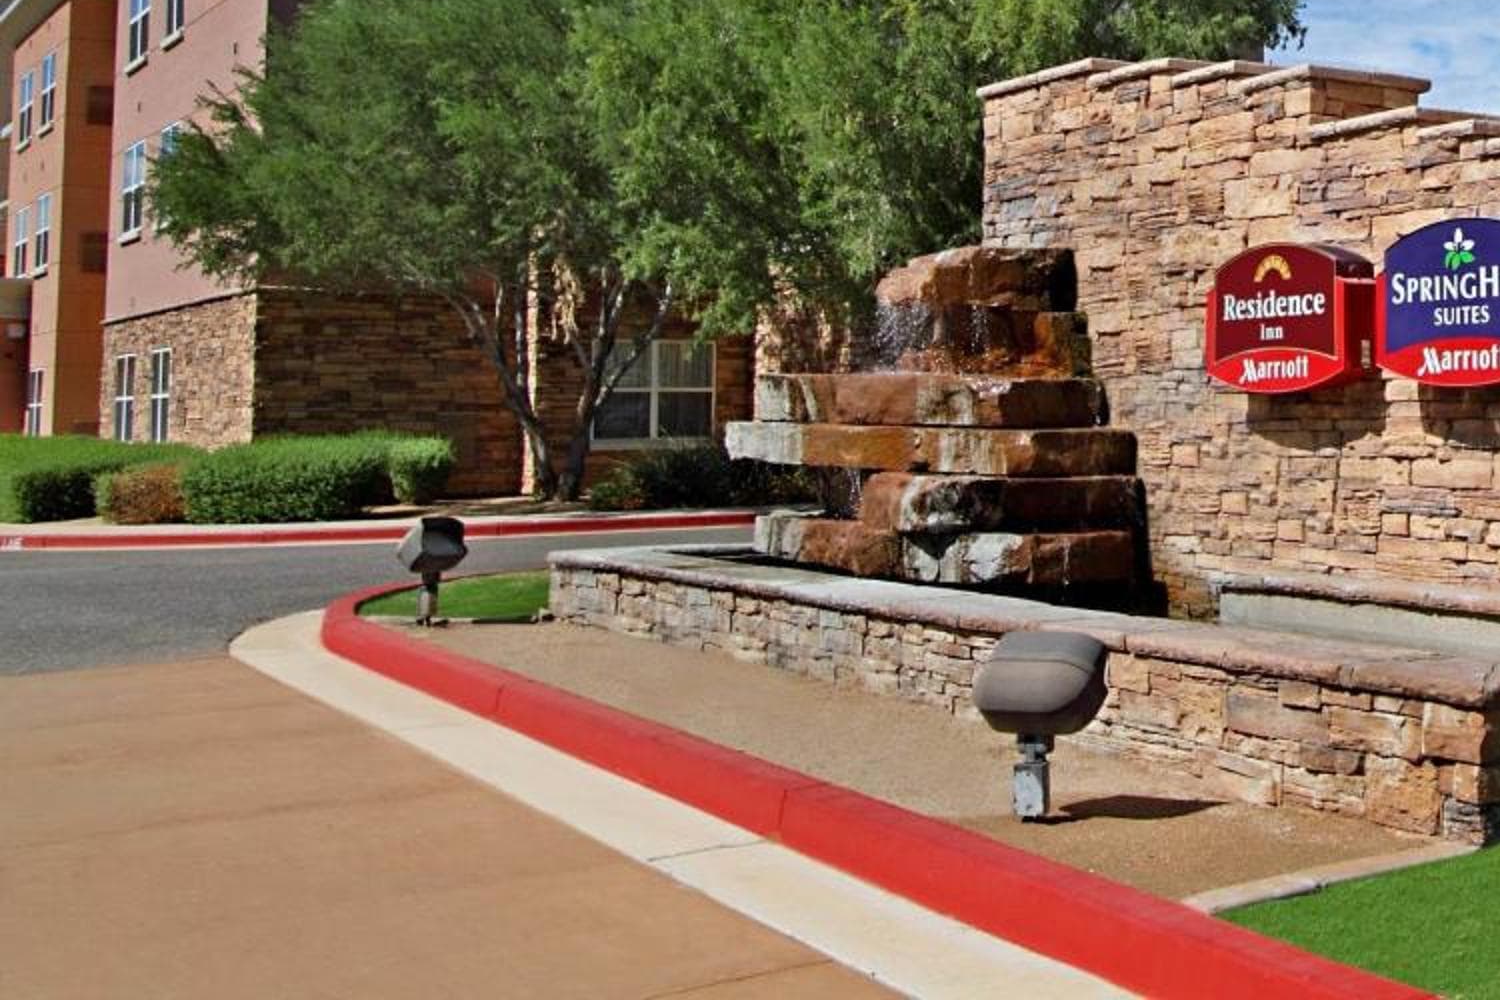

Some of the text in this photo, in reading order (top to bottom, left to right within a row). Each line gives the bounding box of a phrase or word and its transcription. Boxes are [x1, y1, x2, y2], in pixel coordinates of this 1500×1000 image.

[1223, 290, 1325, 321] Residence
[1433, 304, 1490, 326] SUITES
[1261, 323, 1284, 340] Inn
[1238, 354, 1309, 384] Marriott
